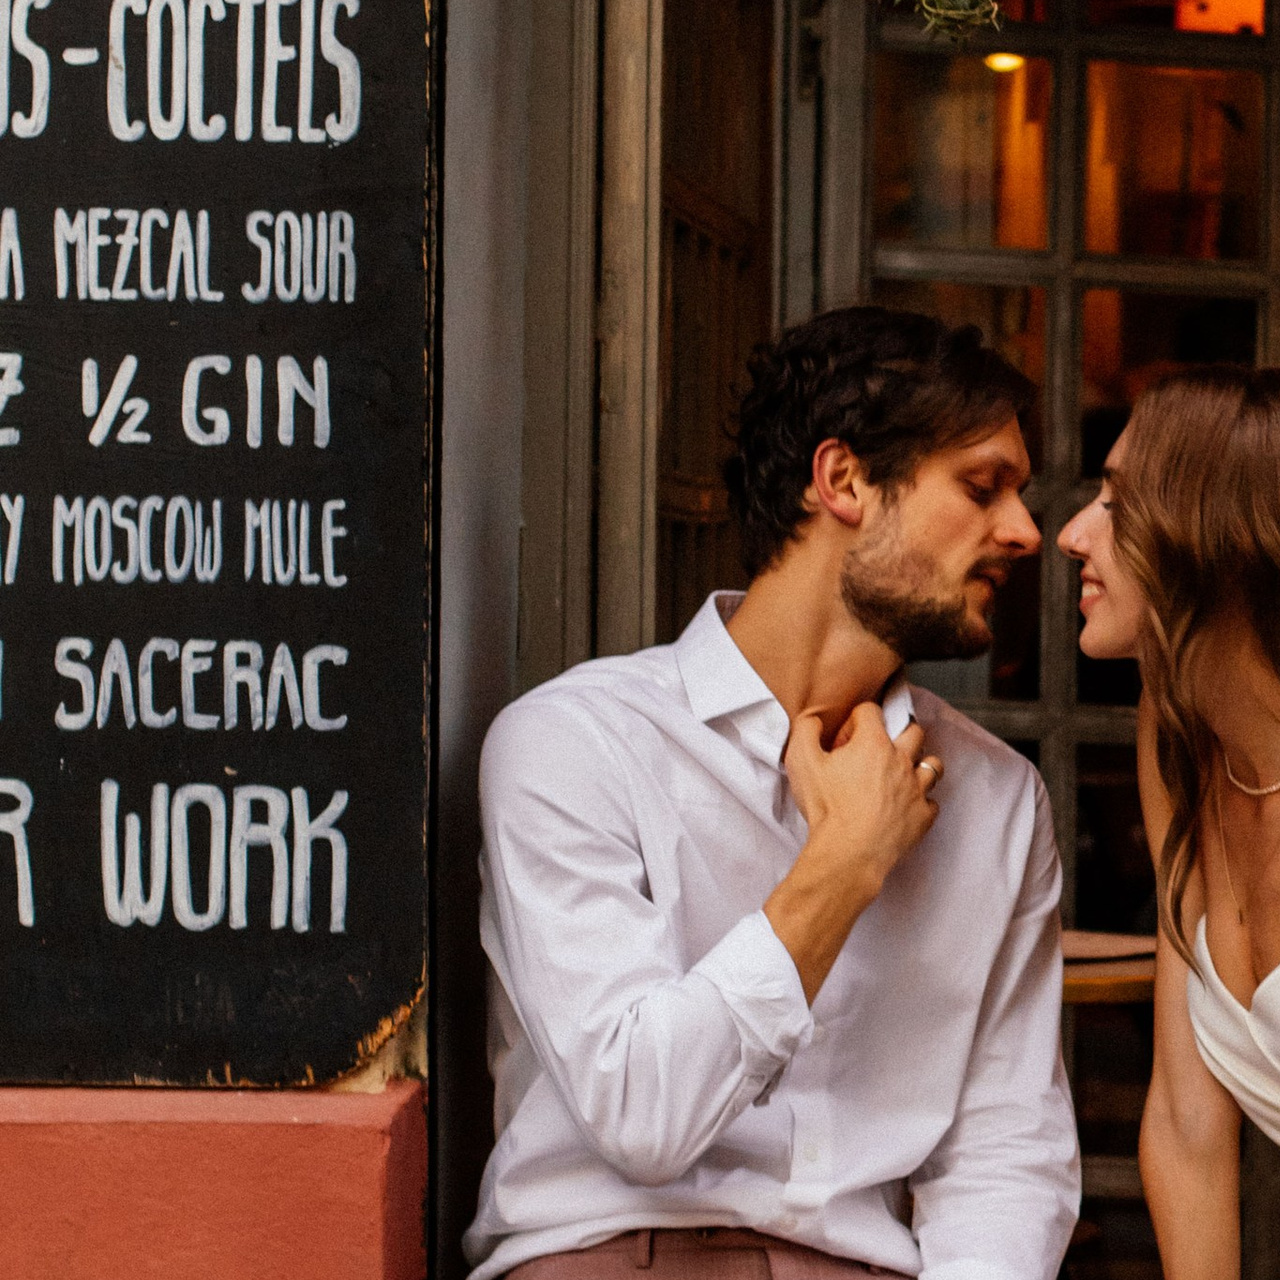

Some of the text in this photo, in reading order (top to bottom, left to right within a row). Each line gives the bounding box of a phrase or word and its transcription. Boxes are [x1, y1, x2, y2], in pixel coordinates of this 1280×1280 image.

[54, 207, 225, 302] MEZCAL
[241, 210, 356, 303] SOUR
[182, 354, 331, 449] GIN
[53, 495, 222, 586] MOSCOW
[245, 499, 348, 587] MULE
[55, 637, 348, 731] SACERAC
[101, 779, 349, 933] WORK
